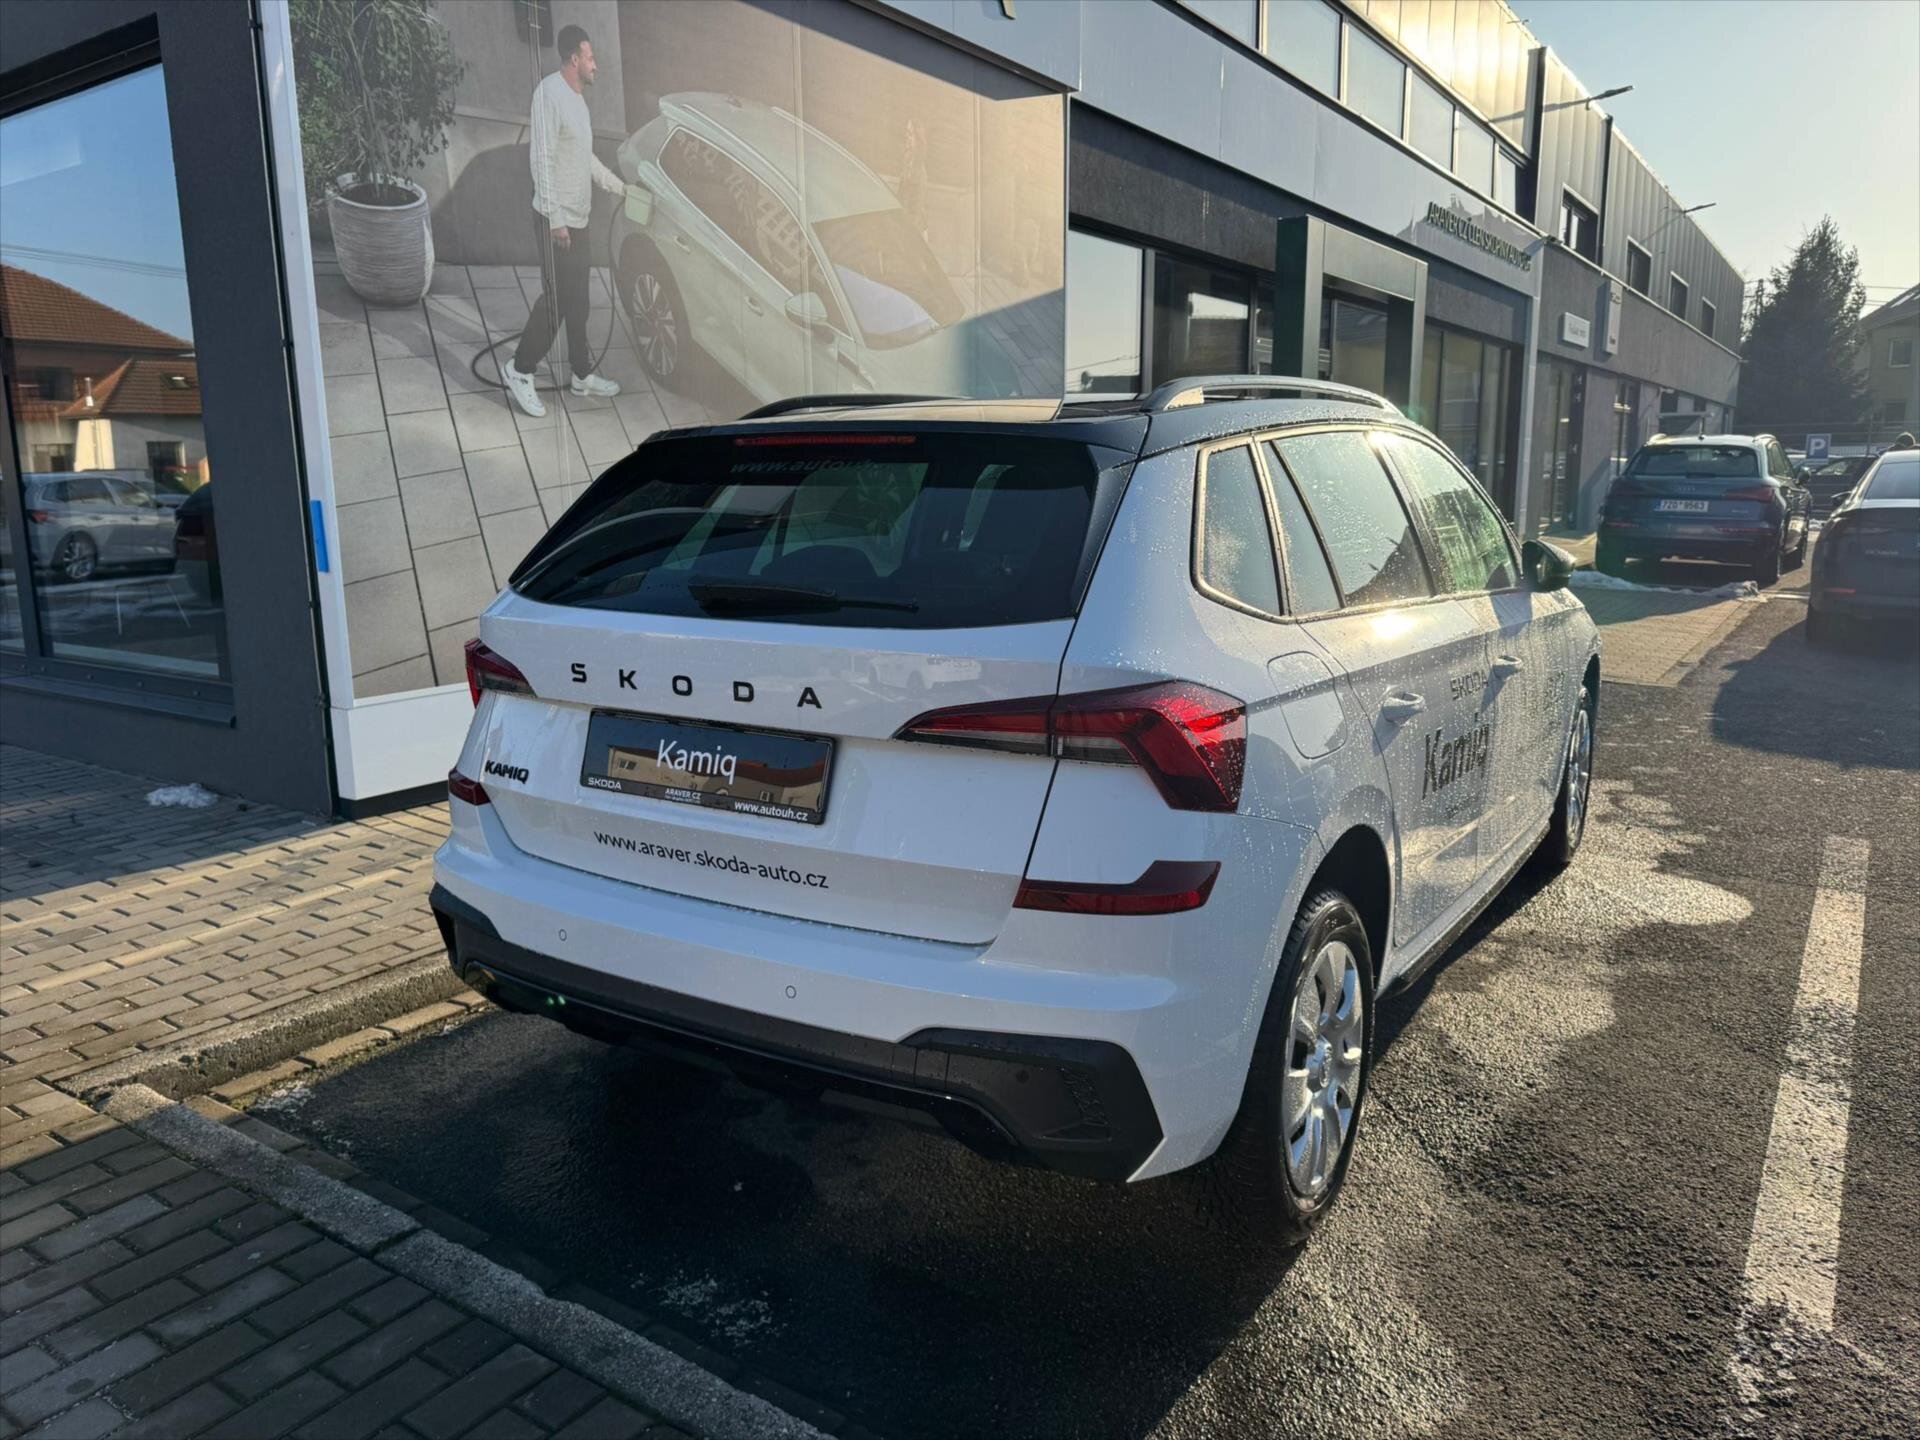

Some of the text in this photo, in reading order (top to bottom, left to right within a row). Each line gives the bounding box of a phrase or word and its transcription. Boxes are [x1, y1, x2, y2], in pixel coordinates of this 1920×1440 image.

[1810, 438, 1826, 456] P
[484, 759, 529, 785] KAMIQ
[657, 739, 738, 785] Kamiq
[1423, 712, 1489, 800] Kamiq
[734, 800, 808, 821] www.autouh.cz
[594, 831, 829, 889] www.araver.skoda-auto.cz
